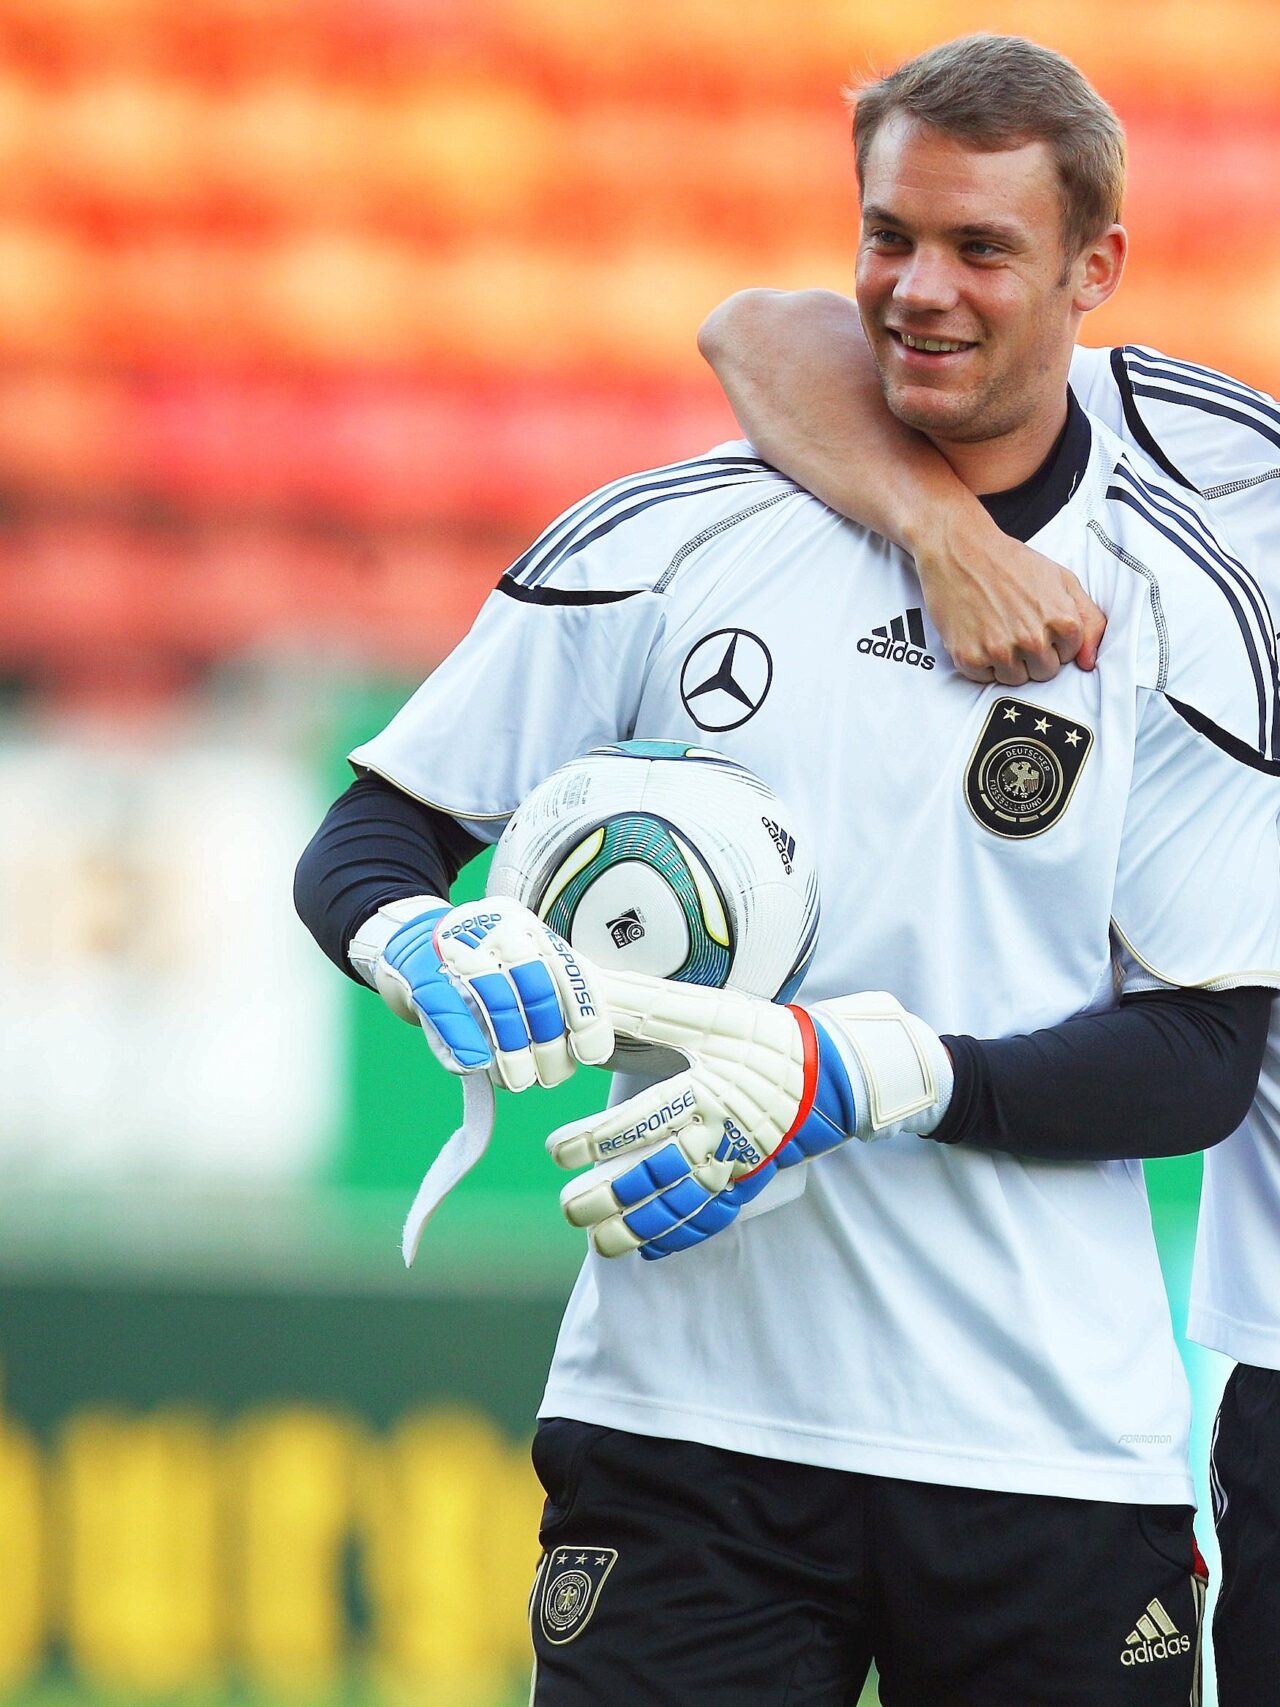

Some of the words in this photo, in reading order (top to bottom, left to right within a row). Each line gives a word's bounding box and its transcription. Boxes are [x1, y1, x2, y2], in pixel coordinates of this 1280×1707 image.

[857, 638, 936, 671] adidas
[1005, 748, 1051, 772] DEUTSCHER
[761, 816, 793, 875] adidas
[441, 913, 502, 940] adidas
[599, 1090, 695, 1153] RESPONSE
[723, 1117, 761, 1165] adidas
[1120, 1634, 1191, 1666] adidas
